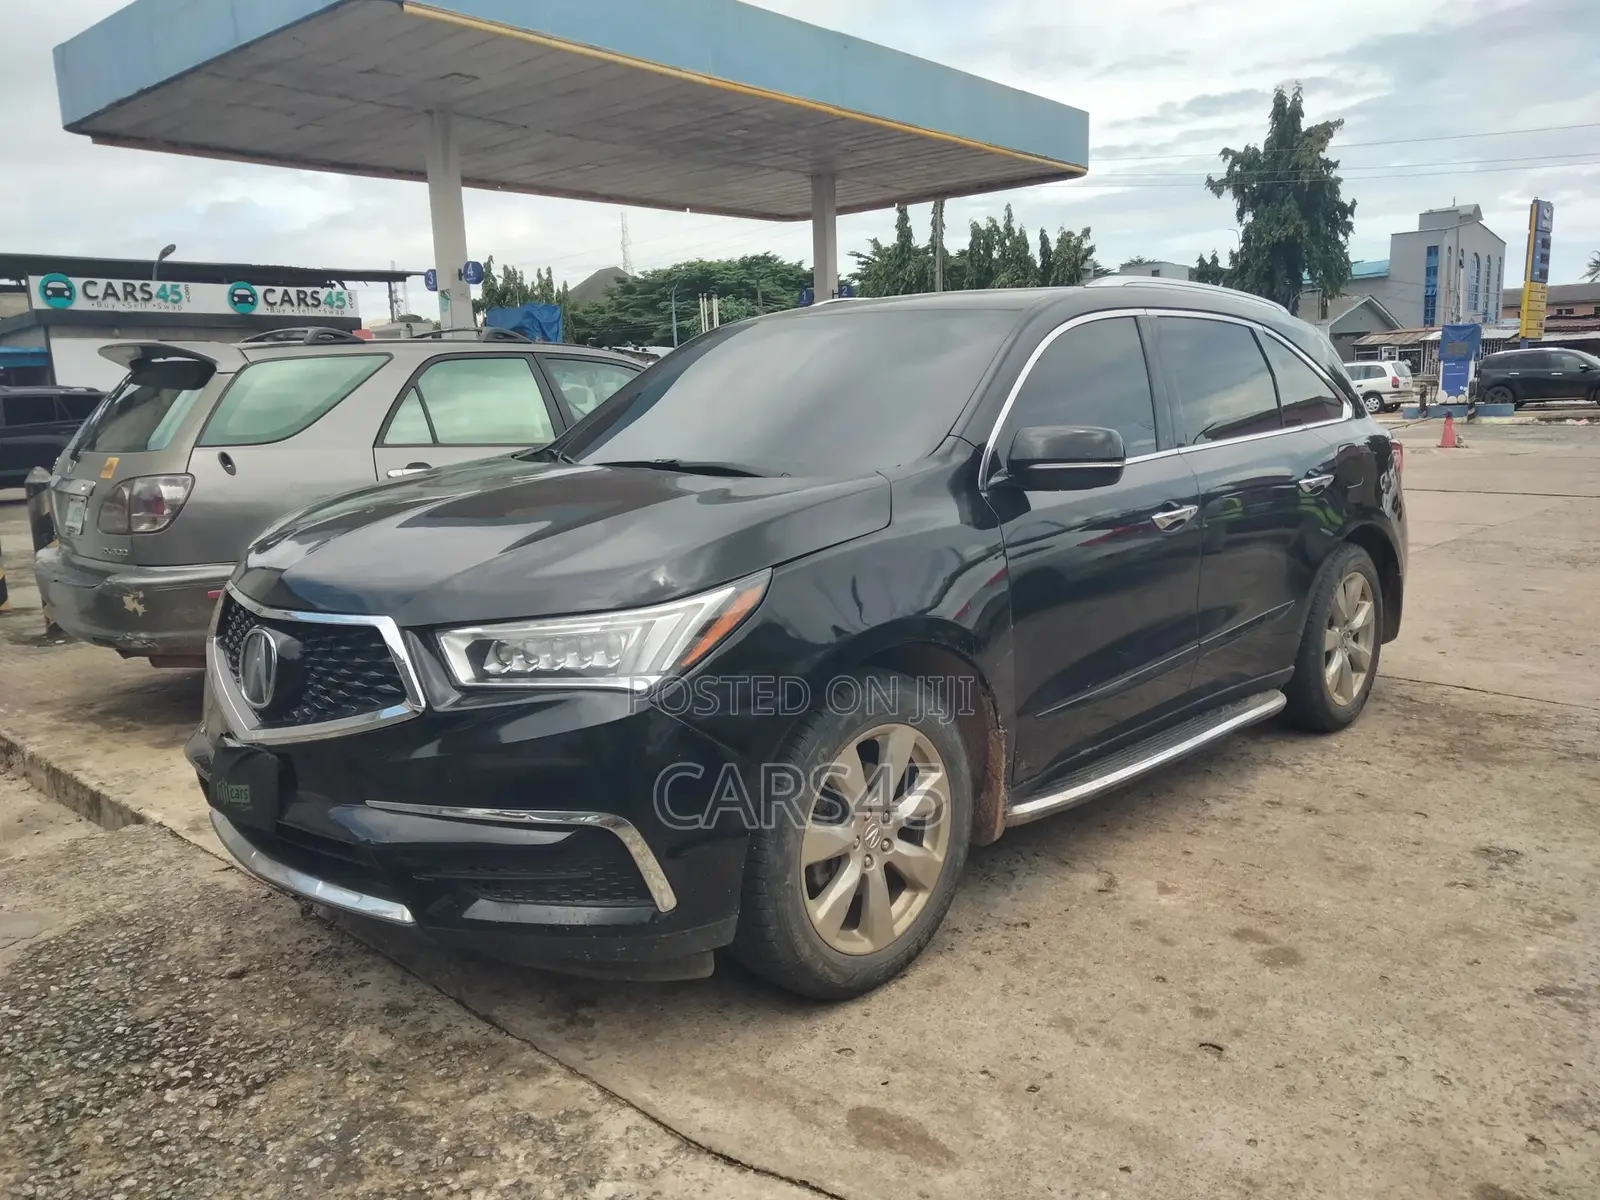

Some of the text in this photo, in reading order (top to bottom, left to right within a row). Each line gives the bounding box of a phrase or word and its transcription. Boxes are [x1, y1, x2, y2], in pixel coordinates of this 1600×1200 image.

[467, 263, 474, 276] 4
[427, 271, 434, 284] 3
[82, 280, 183, 304] CARS45
[263, 288, 347, 309] CARS45
[230, 788, 248, 800] cars
